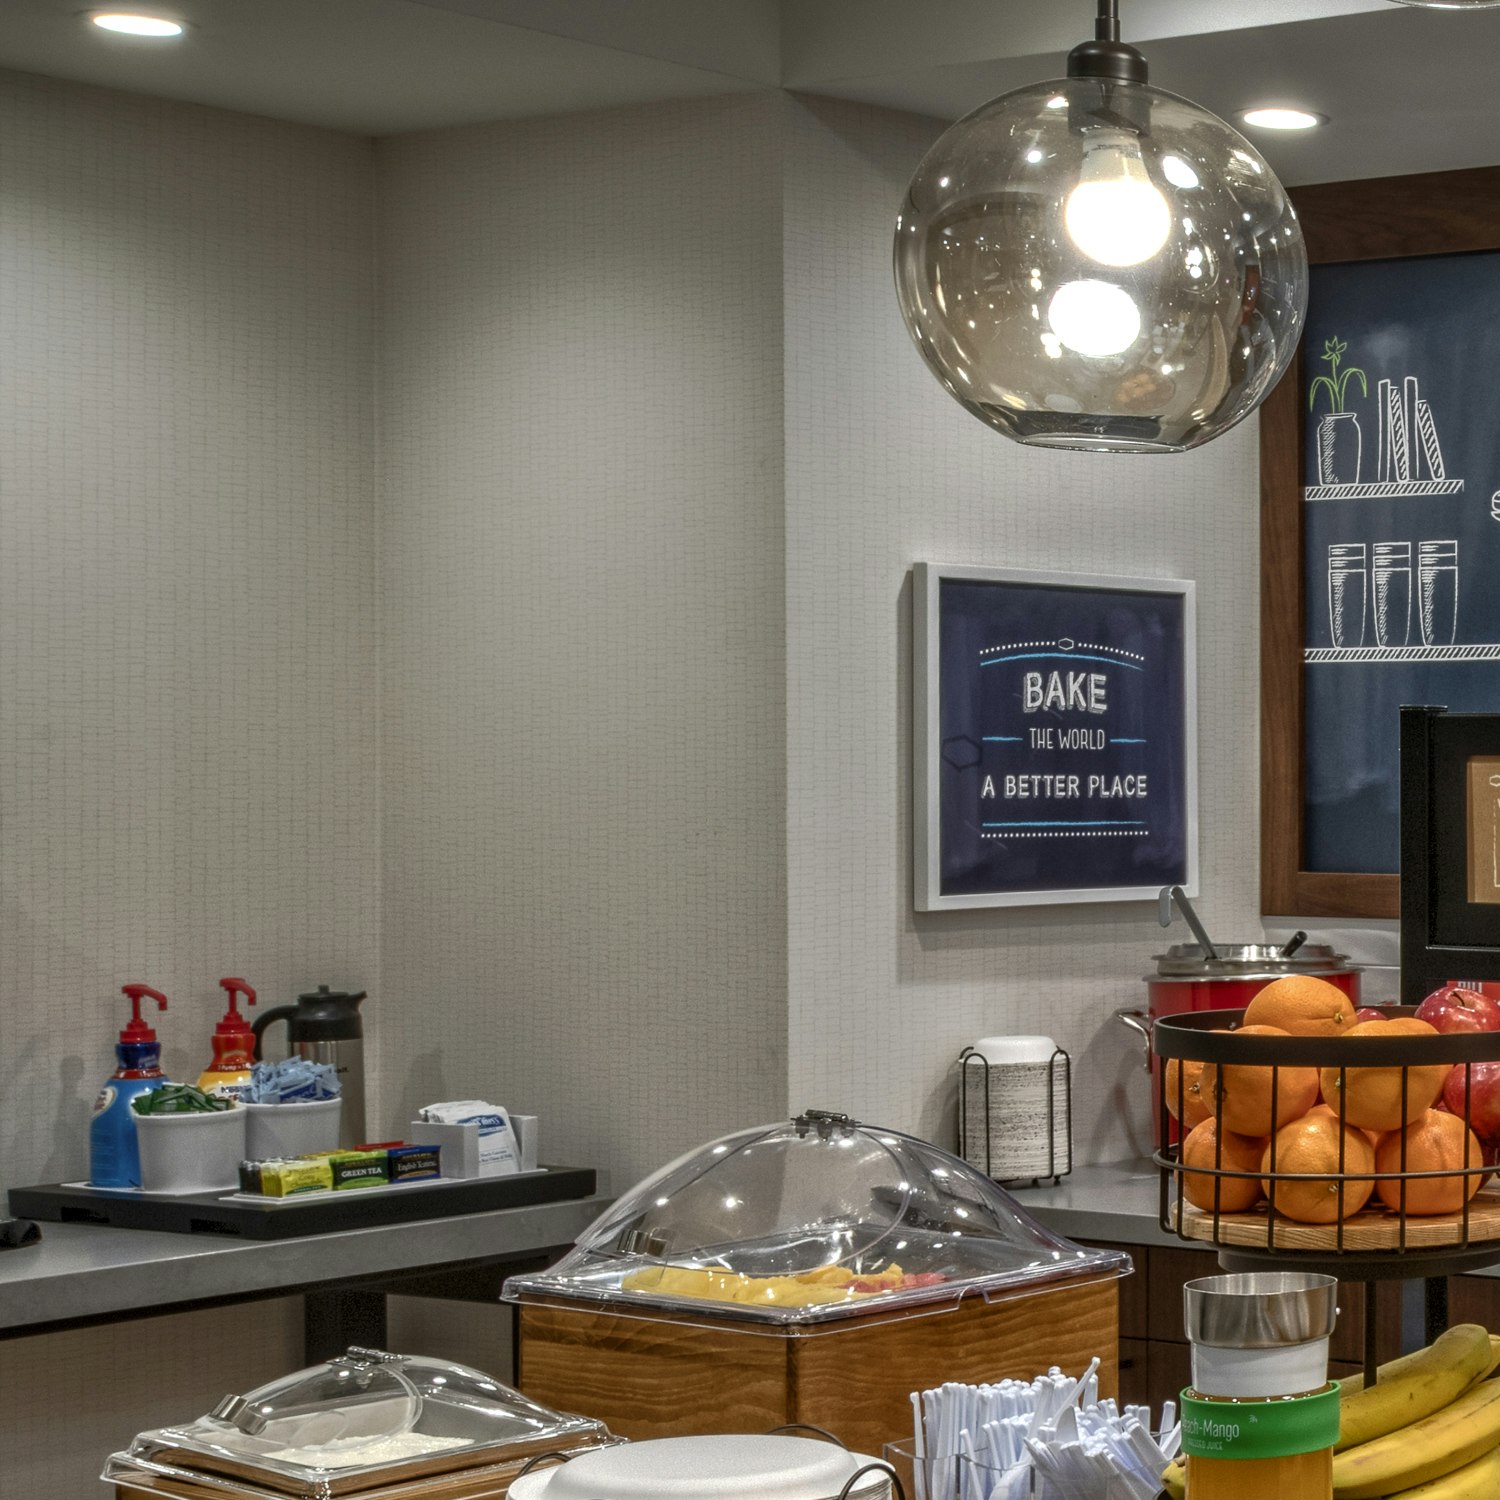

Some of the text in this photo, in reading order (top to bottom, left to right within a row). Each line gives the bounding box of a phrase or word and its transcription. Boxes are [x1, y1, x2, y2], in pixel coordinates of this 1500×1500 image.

[1023, 671, 1108, 714] BAKE
[1029, 728, 1105, 750] THE WORLD
[981, 775, 1147, 799] A BETTER PLACE
[341, 1166, 382, 1178] GREEN TEA
